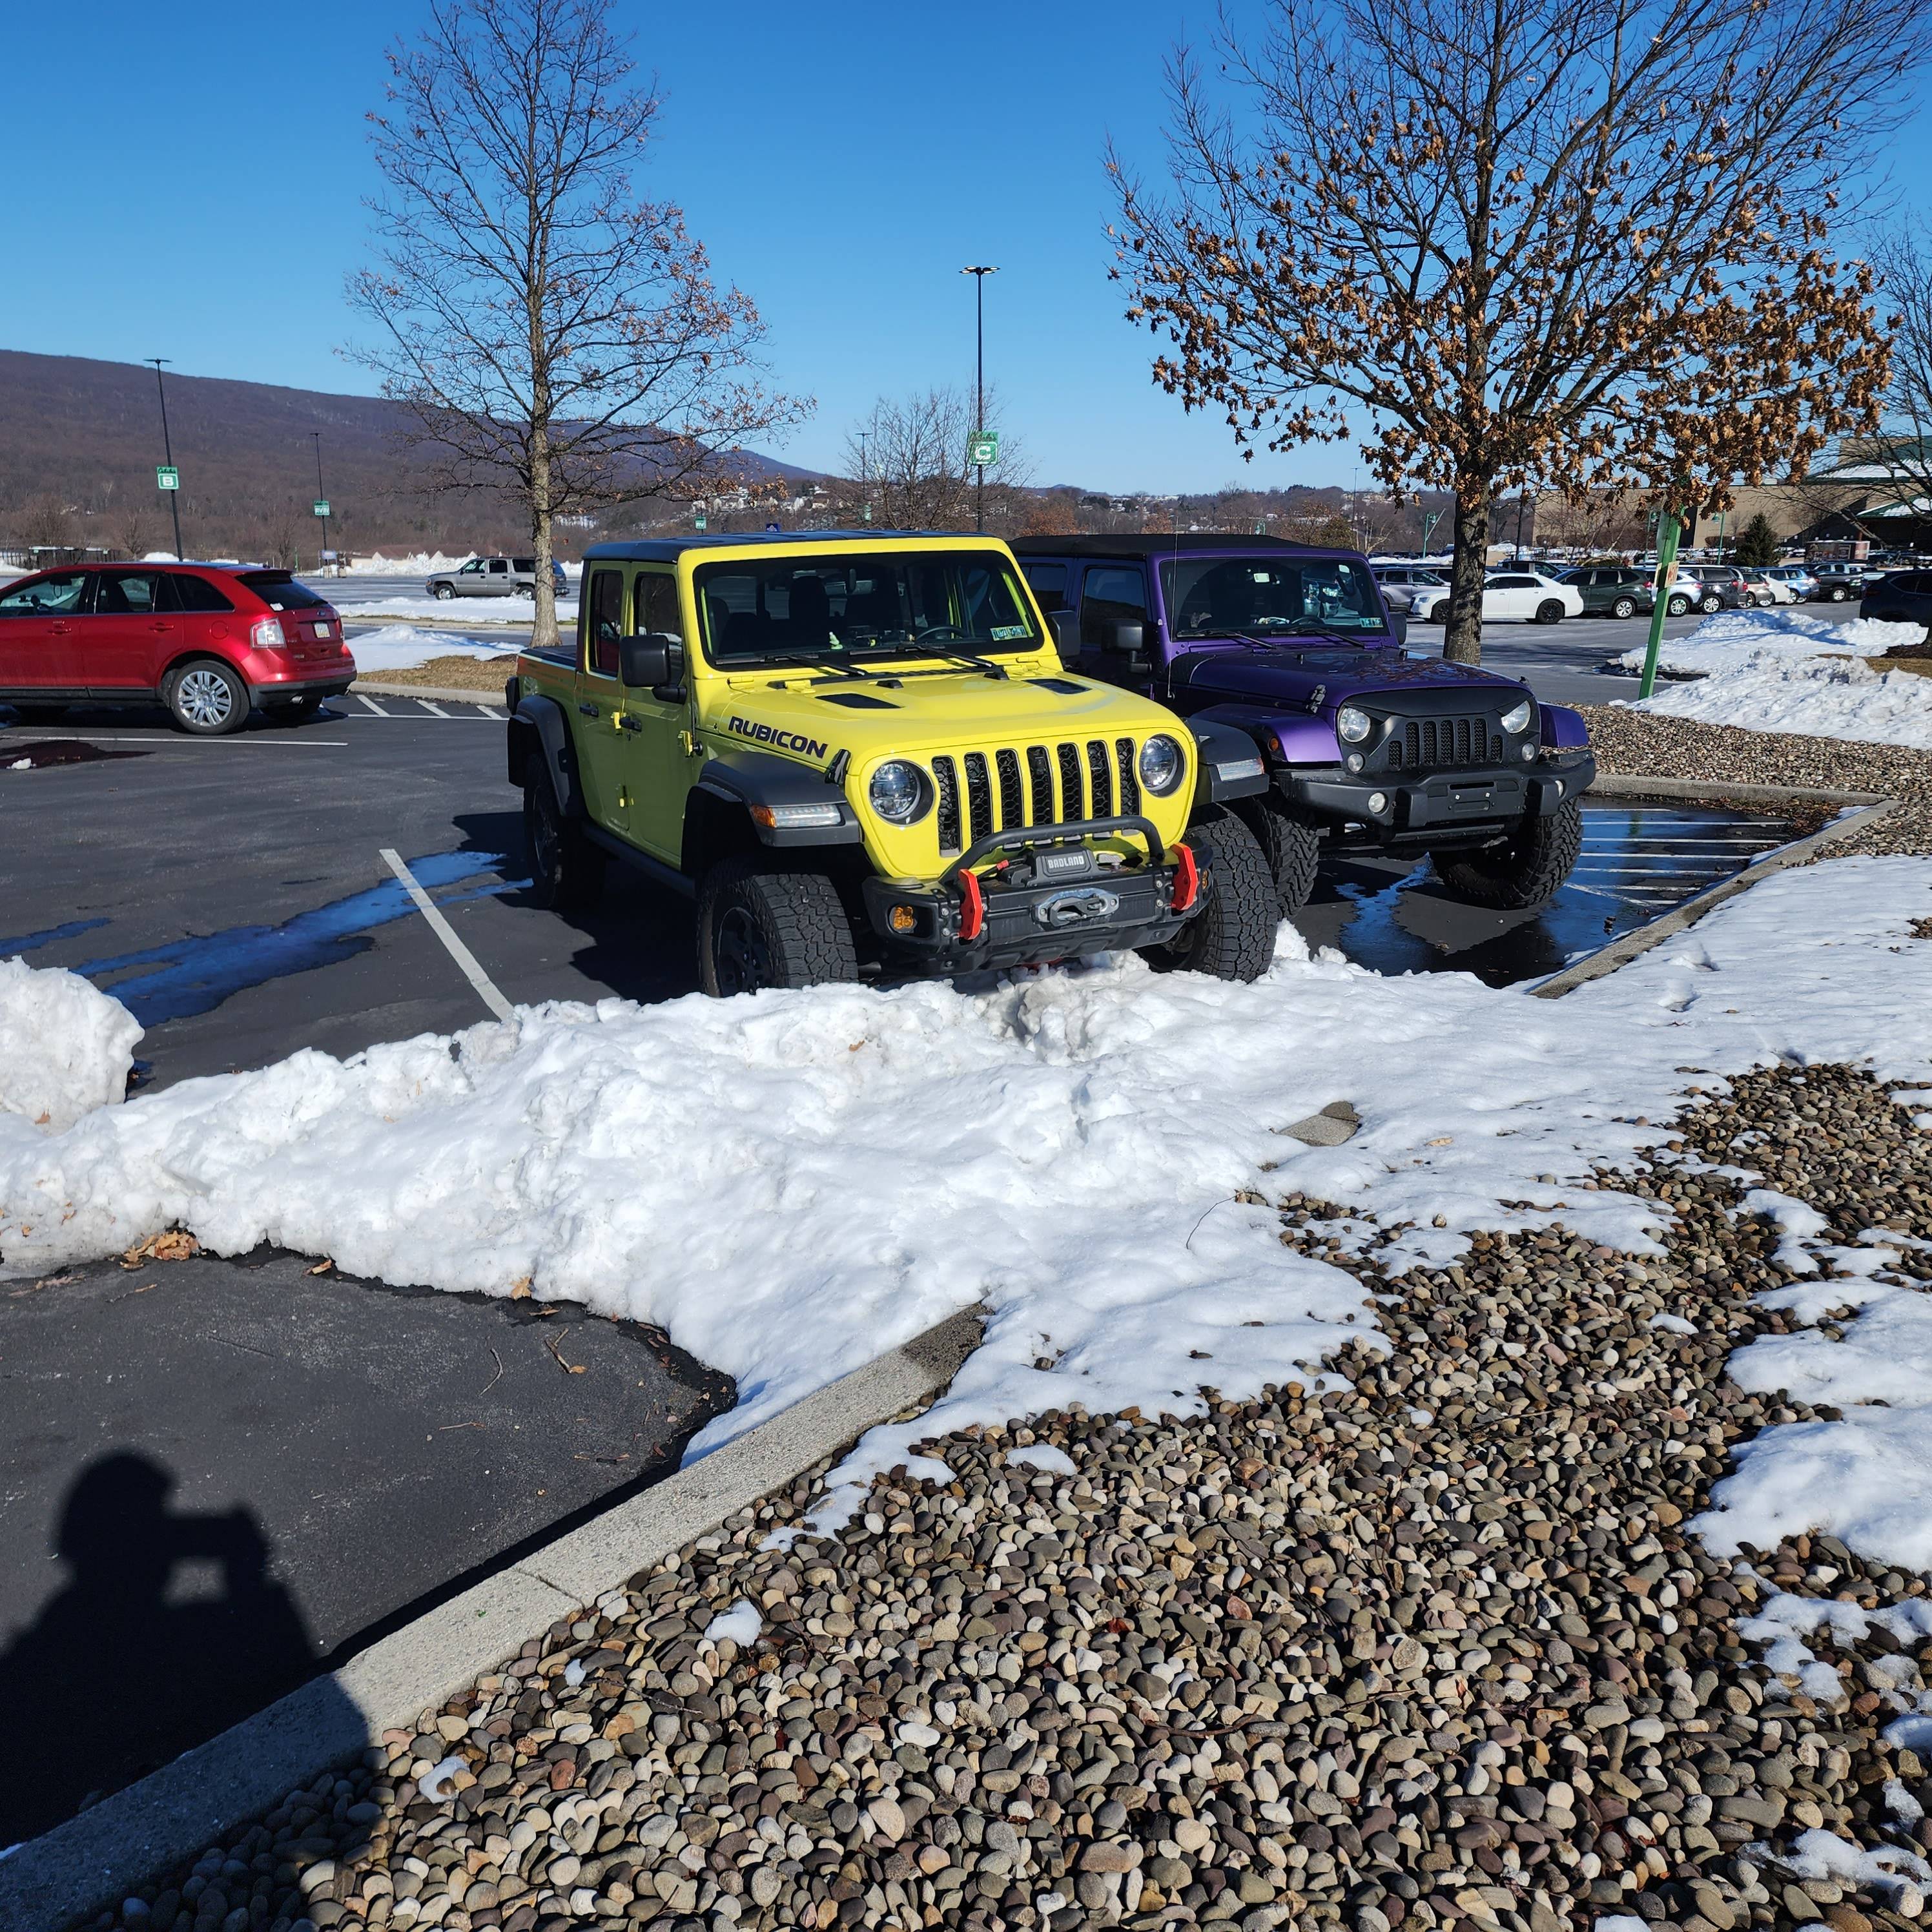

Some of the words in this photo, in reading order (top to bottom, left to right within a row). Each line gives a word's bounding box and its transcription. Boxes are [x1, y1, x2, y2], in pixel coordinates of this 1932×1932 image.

[975, 445, 991, 460] C
[163, 476, 174, 486] B
[728, 716, 828, 759] RUBICON
[1047, 855, 1084, 868] BADLAND
